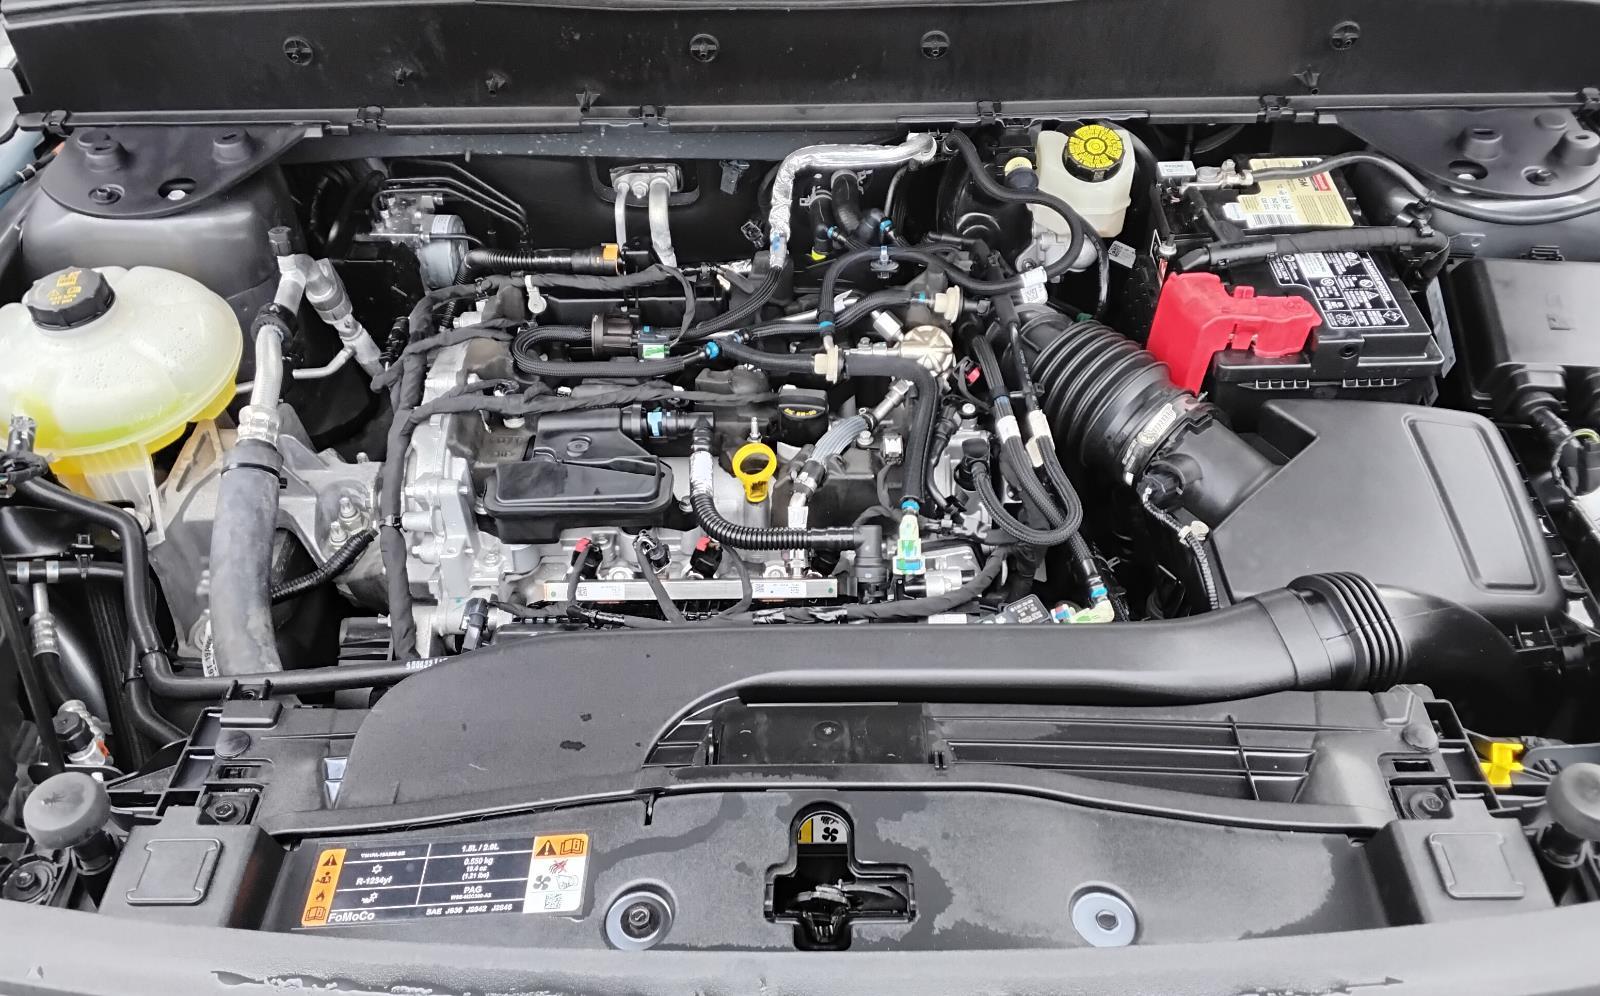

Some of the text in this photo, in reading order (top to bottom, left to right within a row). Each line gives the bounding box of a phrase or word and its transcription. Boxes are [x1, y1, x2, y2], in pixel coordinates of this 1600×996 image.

[355, 875, 393, 886] R-1234yf
[463, 885, 483, 894] PAG
[327, 910, 376, 923] FoMoCo
